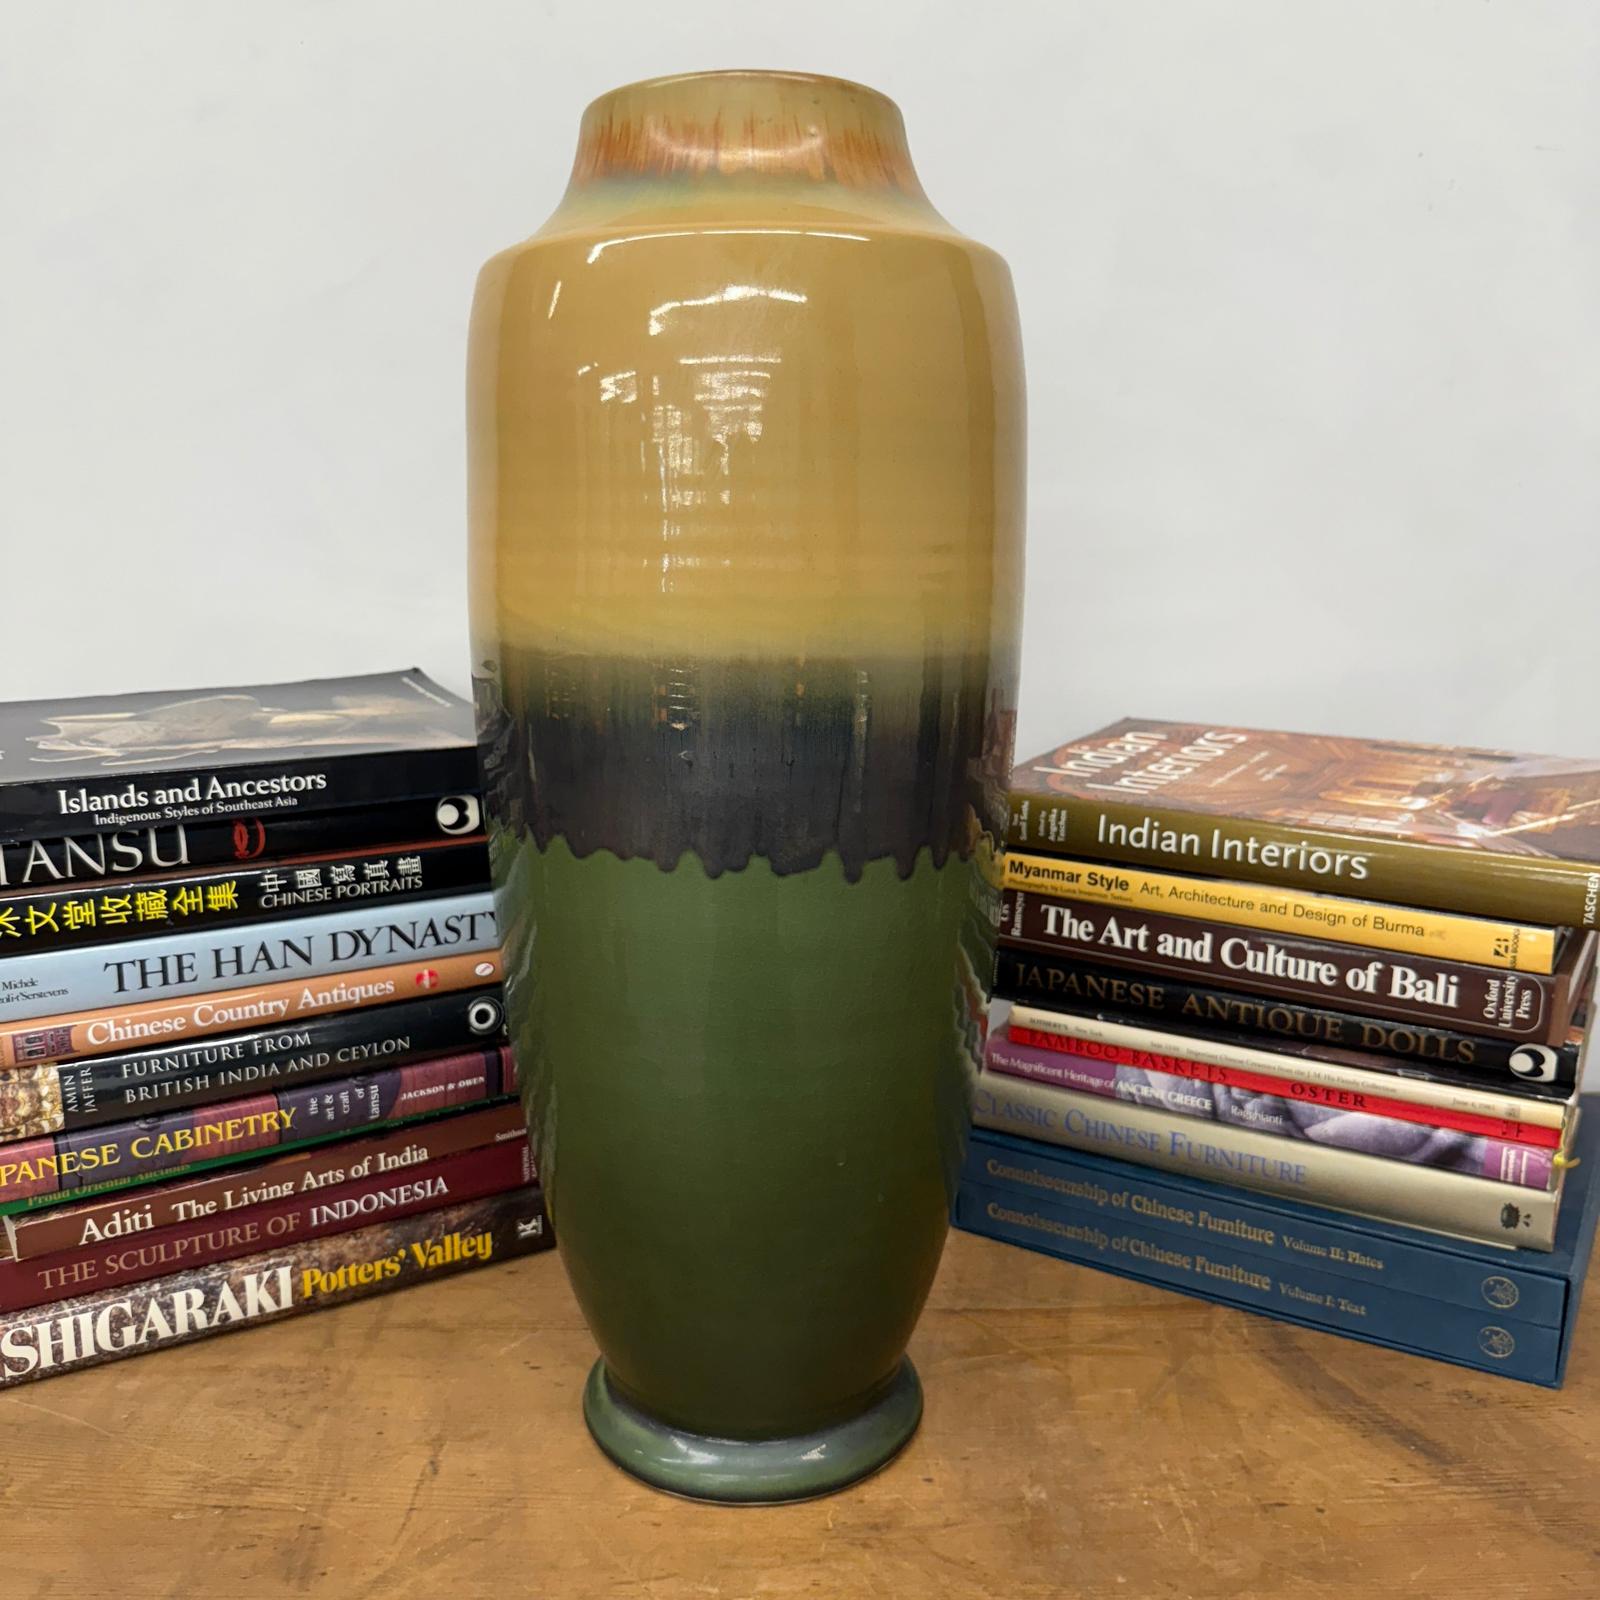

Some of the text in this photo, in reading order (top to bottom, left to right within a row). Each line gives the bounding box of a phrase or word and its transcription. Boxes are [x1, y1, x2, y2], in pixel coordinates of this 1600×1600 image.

[58, 773, 327, 815] Islands and Ancestors
[95, 797, 298, 826] Indigenous Styles of Southeast Asia
[1098, 814, 1369, 880] Indian Interiors
[261, 875, 423, 909] CHINESE PORTRAITS
[1009, 861, 1425, 937] Myanmar Style Art, Architecture and Design of Burma
[1583, 871, 1600, 925] TASCHEN
[104, 953, 199, 993] THE
[212, 936, 315, 979] HAN
[1041, 904, 1460, 1009] The Art and Culture of Bali
[2, 978, 39, 991] Michele
[1483, 979, 1500, 1019] Oxford
[1499, 975, 1519, 1028] University
[1515, 989, 1532, 1019] Press
[86, 979, 395, 1045] Chinese Country Antiques
[1016, 963, 1166, 1010] JAPANESE
[1182, 992, 1344, 1041] ANTIQUE
[1362, 1023, 1477, 1064] DOLLS
[122, 1031, 312, 1079] FURNITURE FROM
[125, 1036, 411, 1104] BRITISH INDIA AND CEYLON
[64, 1074, 79, 1113] AMIN
[81, 1067, 98, 1114] JAFFER
[309, 1097, 319, 1116] the
[324, 1094, 335, 1121] art &
[339, 1090, 350, 1114] craft
[368, 1084, 381, 1120] tansu
[400, 1076, 486, 1101] JACKSON & OWEN
[992, 1052, 1283, 1126] The Magnificent Heritage of ANCIENT GREECE Ragghianti
[1290, 1082, 1367, 1107] OSTER
[131, 1107, 298, 1159] CABINETRY
[973, 1087, 1307, 1184] CLASSIC CHINESE FURNITURE
[78, 1204, 155, 1246] Aditi
[171, 1199, 218, 1222] The
[223, 1179, 294, 1210] Living
[301, 1168, 345, 1193] Arts
[351, 1156, 373, 1177] of
[377, 1144, 430, 1171] India
[986, 1159, 1109, 1207] Connoisseurship
[1111, 1191, 1128, 1208] of
[1131, 1195, 1194, 1226] Chinese
[1198, 1210, 1275, 1246] Furniture
[1283, 1235, 1327, 1257] Volume
[1347, 1250, 1384, 1270] Plates
[38, 1176, 449, 1290] THE SCULPTURE OF INDONESIA
[986, 1201, 1109, 1250] Connoisseurship
[1112, 1236, 1129, 1252] of
[1129, 1239, 1192, 1270] Chinese
[1195, 1256, 1271, 1291] Furniture
[1279, 1282, 1323, 1306] Volume
[1337, 1297, 1367, 1316] Text
[1, 1231, 493, 1378] SHIGARAKI Potters' Valley
